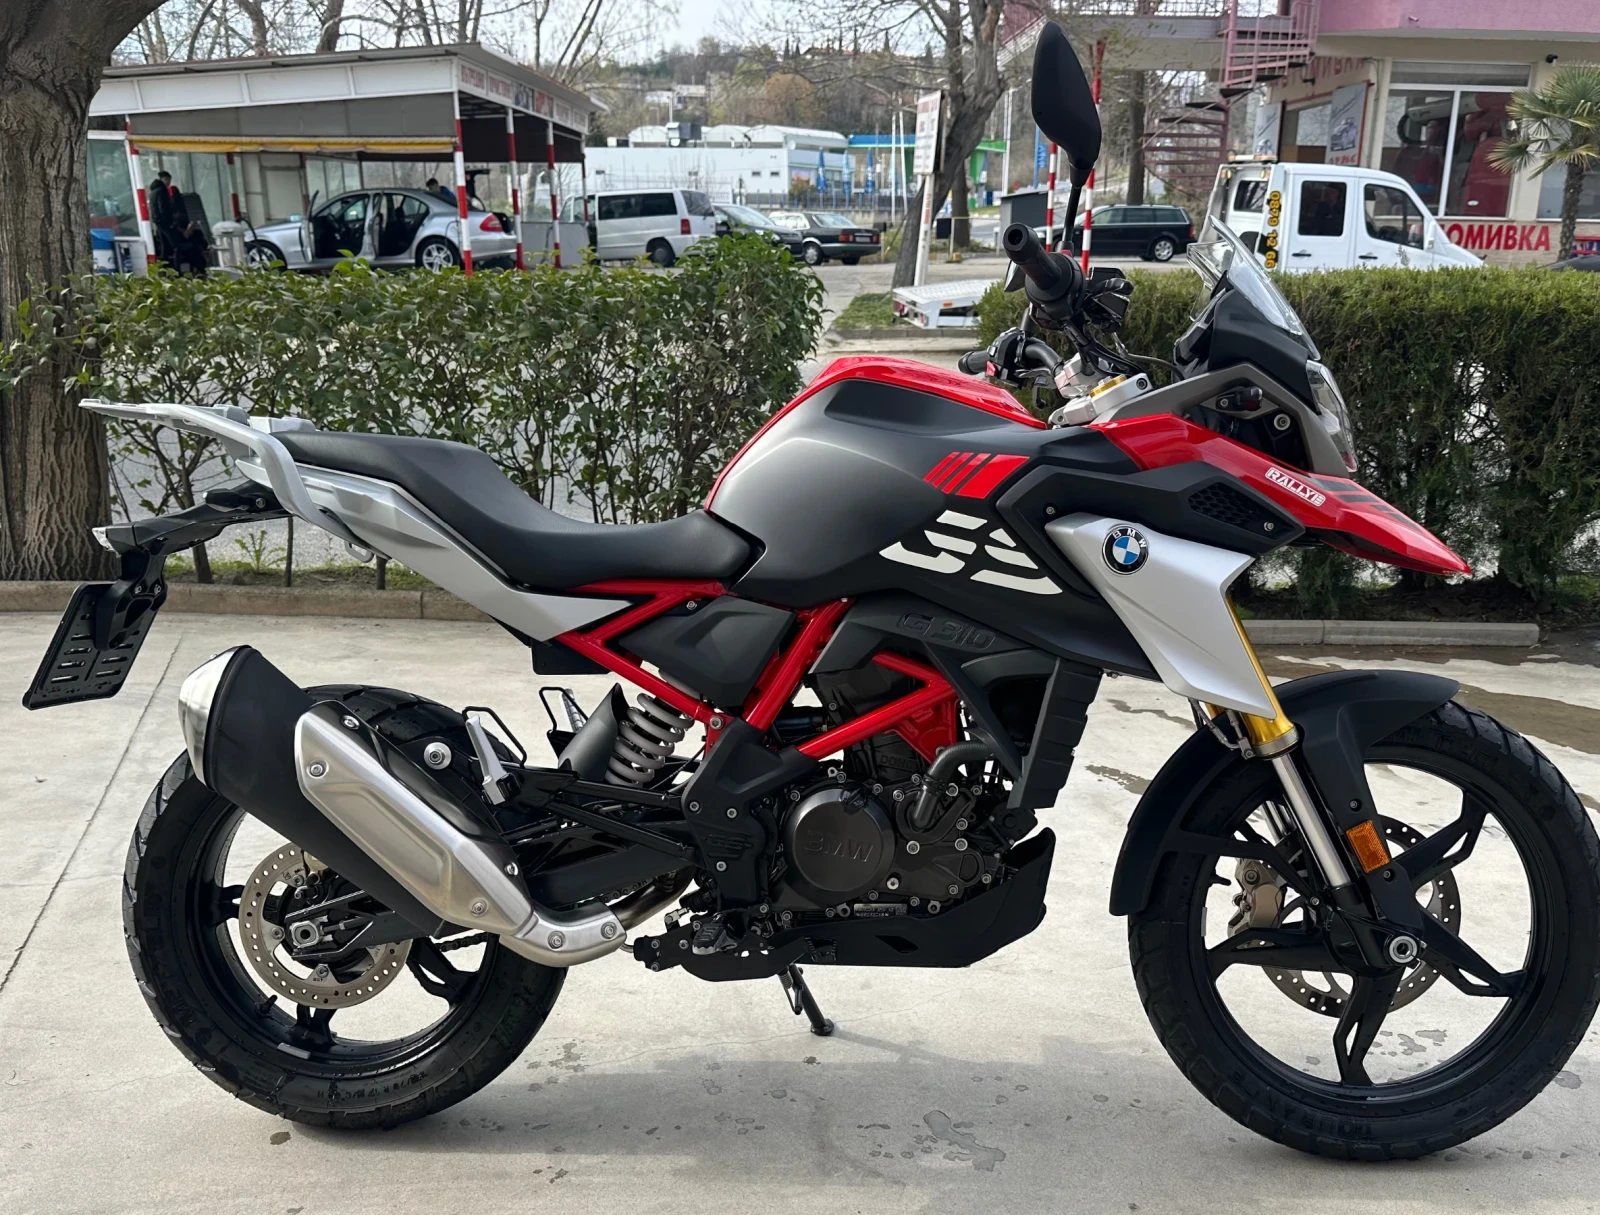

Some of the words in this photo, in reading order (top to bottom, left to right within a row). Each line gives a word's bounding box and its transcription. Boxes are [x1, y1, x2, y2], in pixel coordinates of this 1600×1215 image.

[1267, 190, 1282, 227] 0879
[1266, 229, 1279, 248] 12
[1406, 223, 1550, 251] ОМИВКА
[1264, 250, 1277, 269] 66
[1266, 468, 1325, 506] RALLYE
[1112, 527, 1147, 548] BMW
[897, 612, 935, 637] G
[931, 620, 996, 651] 310
[804, 829, 874, 863] BMW
